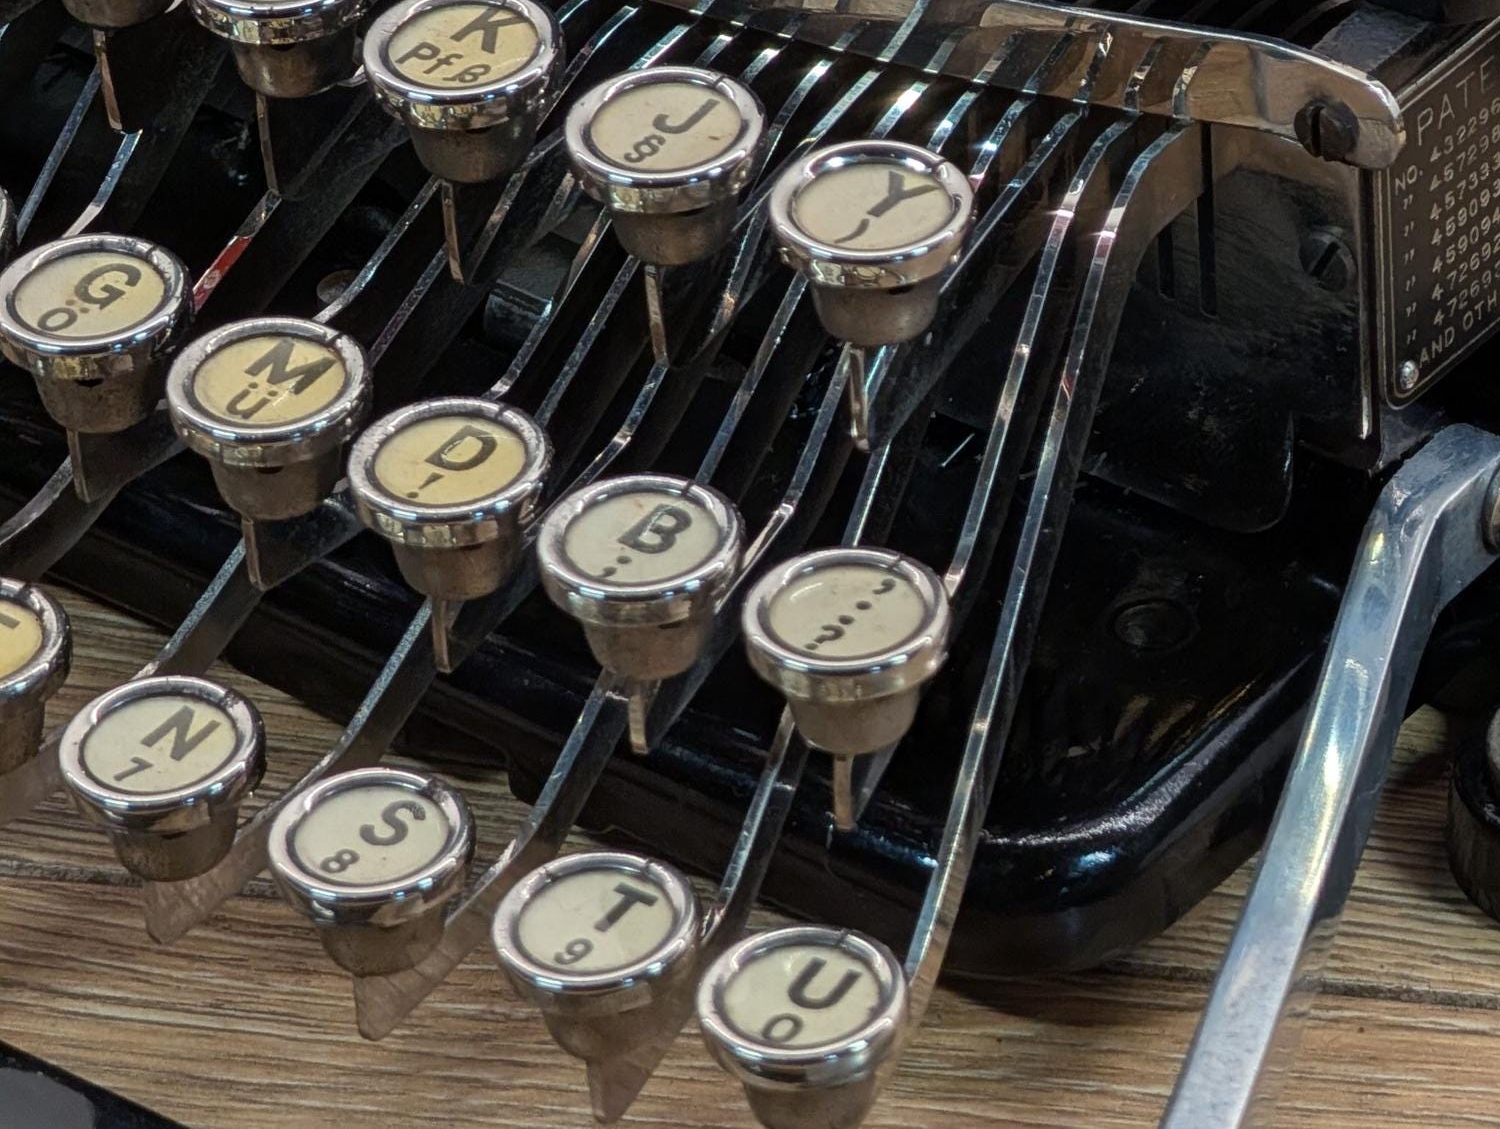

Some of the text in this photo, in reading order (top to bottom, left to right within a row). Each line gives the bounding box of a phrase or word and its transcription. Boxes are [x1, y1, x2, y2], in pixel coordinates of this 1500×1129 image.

[450, 6, 528, 54] K
[653, 98, 720, 136] J
[1430, 98, 1500, 162] 432296
[1430, 125, 1500, 192] 457298
[866, 170, 941, 217] Y
[1430, 151, 1500, 220] 457333
[74, 262, 141, 311] G
[245, 339, 336, 395] M
[1419, 326, 1455, 368] AND
[425, 425, 498, 472] D
[617, 503, 692, 554] B
[141, 705, 222, 761] N
[360, 800, 426, 847] S
[321, 849, 361, 873] 8
[594, 882, 658, 932] T
[553, 937, 593, 966] 9
[788, 957, 863, 1010] U
